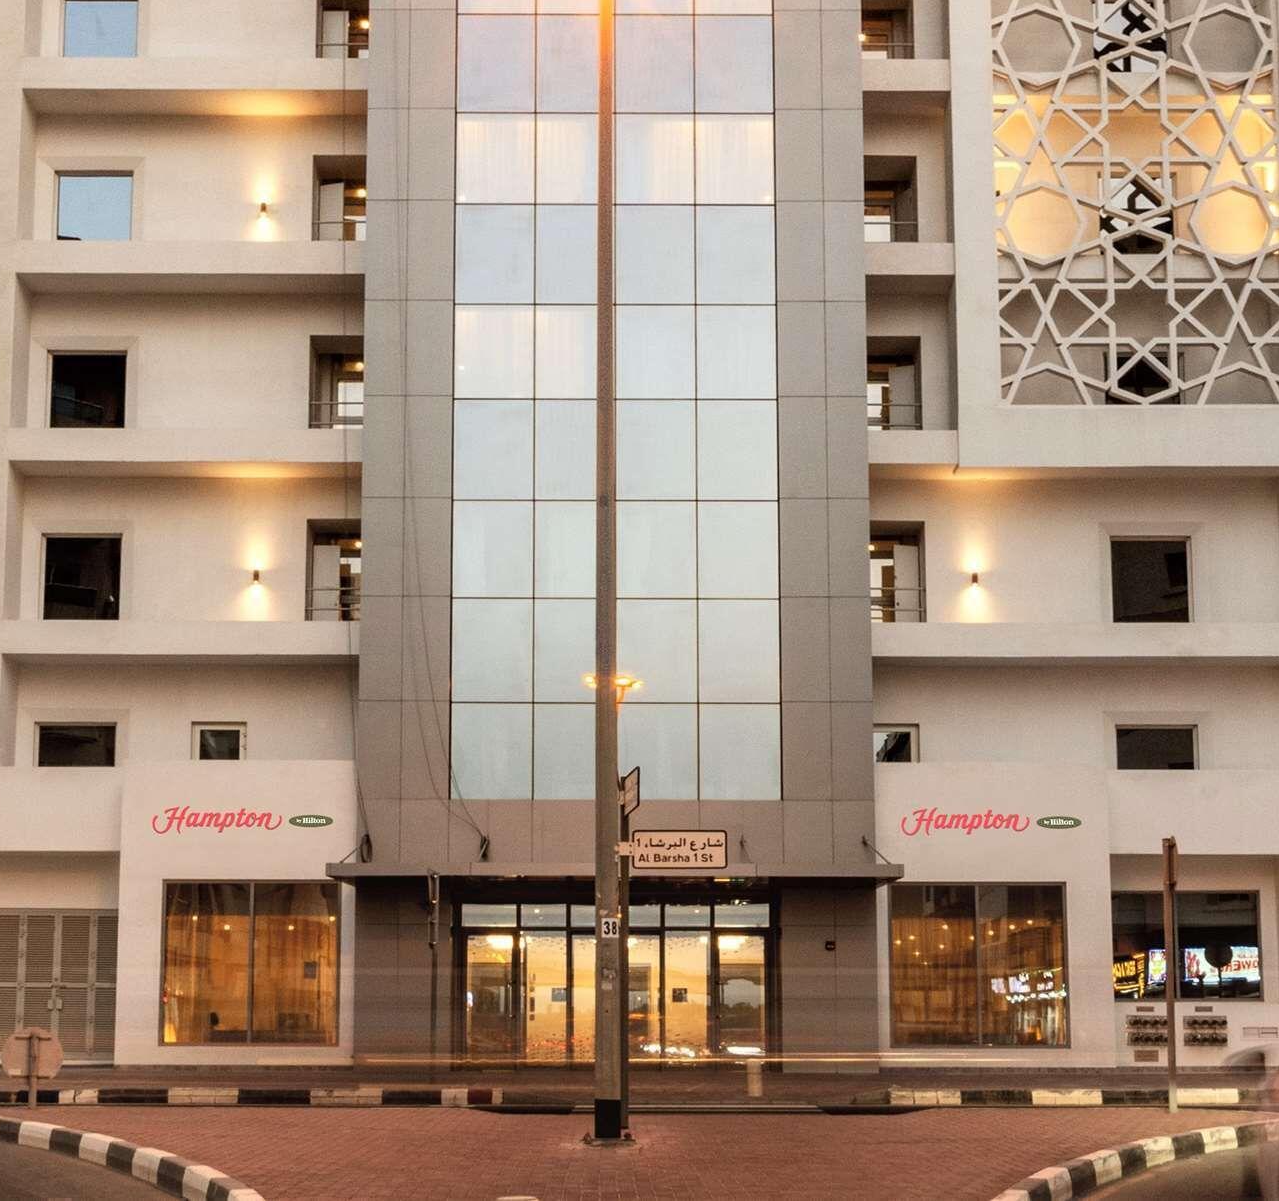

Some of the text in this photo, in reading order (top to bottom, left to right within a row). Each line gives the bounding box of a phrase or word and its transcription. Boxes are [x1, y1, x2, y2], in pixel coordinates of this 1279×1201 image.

[152, 805, 282, 834] Hampton
[302, 816, 326, 825] Hilton
[900, 807, 1030, 836] Hampton
[1050, 818, 1074, 826] Hilton
[644, 838, 686, 851] البرشاء
[690, 838, 723, 851] شارع
[638, 853, 650, 863] Al
[653, 853, 690, 863] Barsha
[701, 853, 713, 863] St
[603, 921, 617, 935] 38
